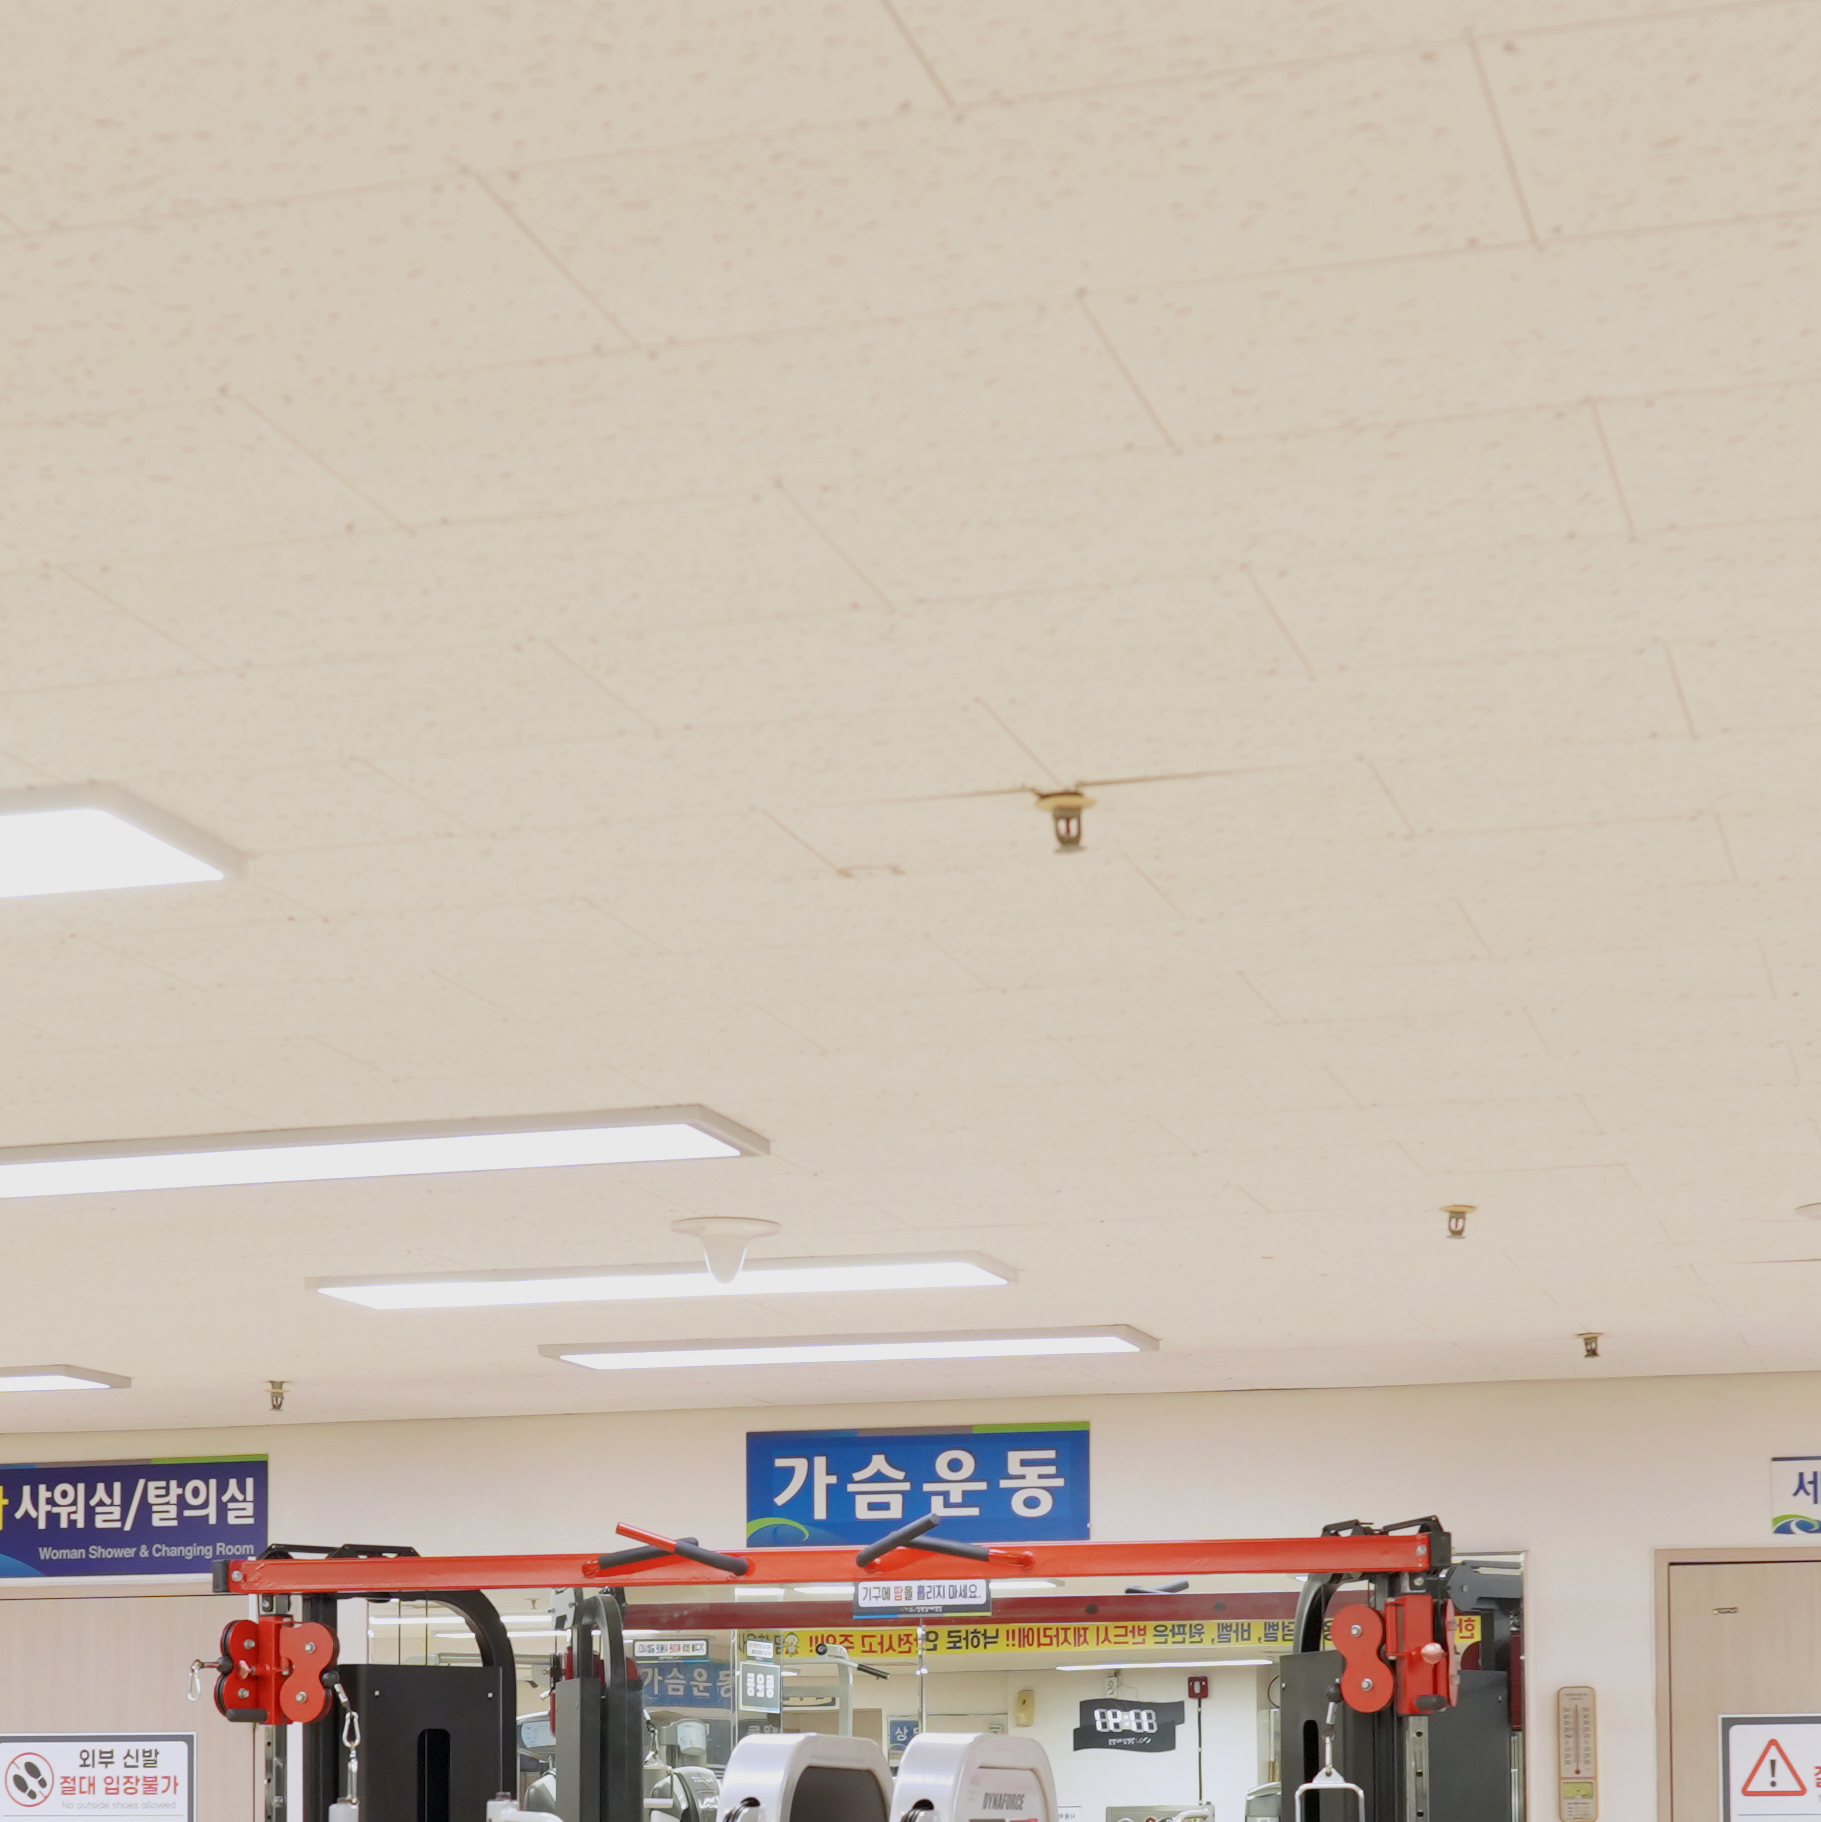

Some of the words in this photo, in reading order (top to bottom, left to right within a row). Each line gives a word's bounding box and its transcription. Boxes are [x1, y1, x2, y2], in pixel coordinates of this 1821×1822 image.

[773, 1449, 1065, 1520] 가슴운동
[14, 1477, 255, 1531] 샤워실/탈의실
[39, 1546, 85, 1560] Woman
[88, 1545, 137, 1559] Shower
[140, 1545, 149, 1557] &
[152, 1544, 213, 1559] Changing
[216, 1543, 254, 1555] Room
[862, 1586, 890, 1601] 기구에
[79, 1749, 115, 1769] 외부
[123, 1749, 159, 1769] 신발
[60, 1776, 96, 1795] 절대
[104, 1775, 179, 1795] 입장불가
[77, 1801, 110, 1809] outside
[112, 1801, 138, 1809] shoes
[141, 1801, 176, 1809] allowed
